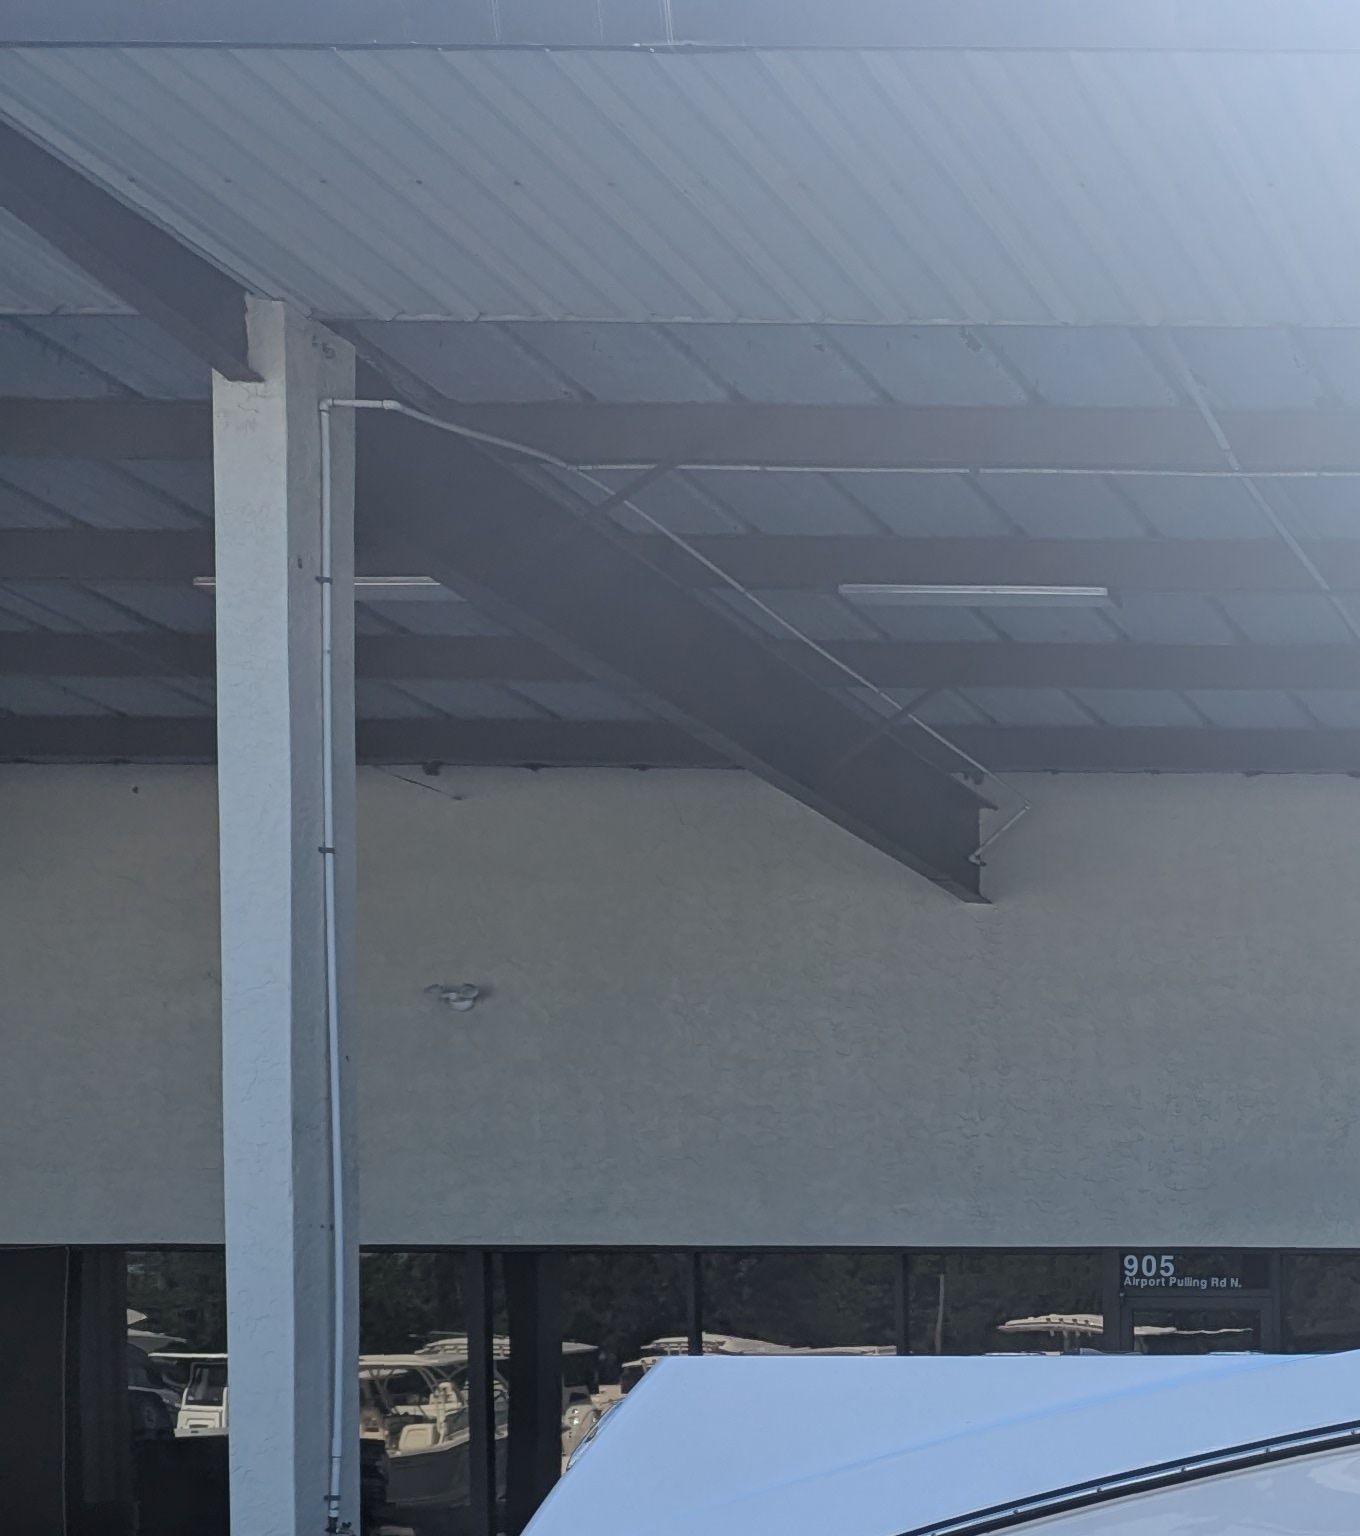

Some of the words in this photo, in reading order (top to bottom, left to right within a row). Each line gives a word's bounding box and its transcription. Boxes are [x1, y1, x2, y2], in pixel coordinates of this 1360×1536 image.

[1123, 1254, 1175, 1277] 905
[1123, 1276, 1165, 1289] Airport
[1169, 1277, 1208, 1290] Pulling
[1211, 1277, 1227, 1288] Rd
[1230, 1278, 1242, 1288] N.
